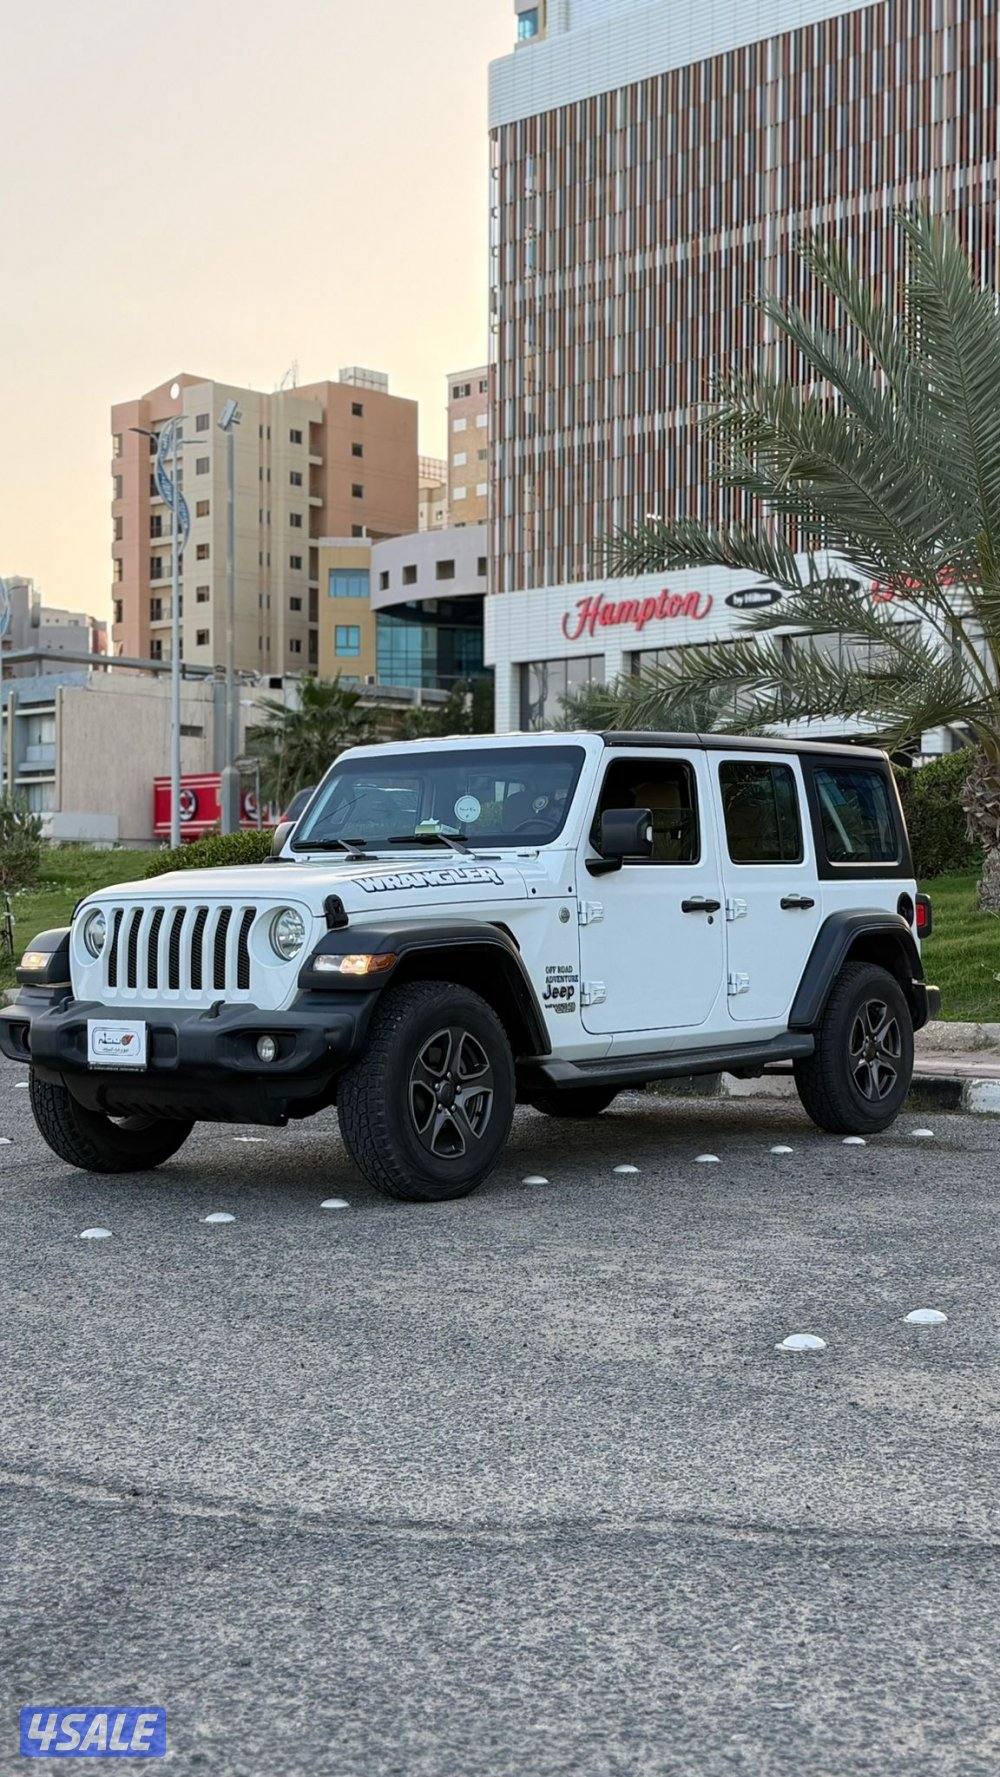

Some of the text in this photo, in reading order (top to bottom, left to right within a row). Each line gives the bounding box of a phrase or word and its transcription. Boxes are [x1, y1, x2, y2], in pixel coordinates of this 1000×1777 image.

[562, 588, 713, 640] Hampton
[351, 866, 504, 893] WRANGLER
[542, 984, 575, 1000] Jeep
